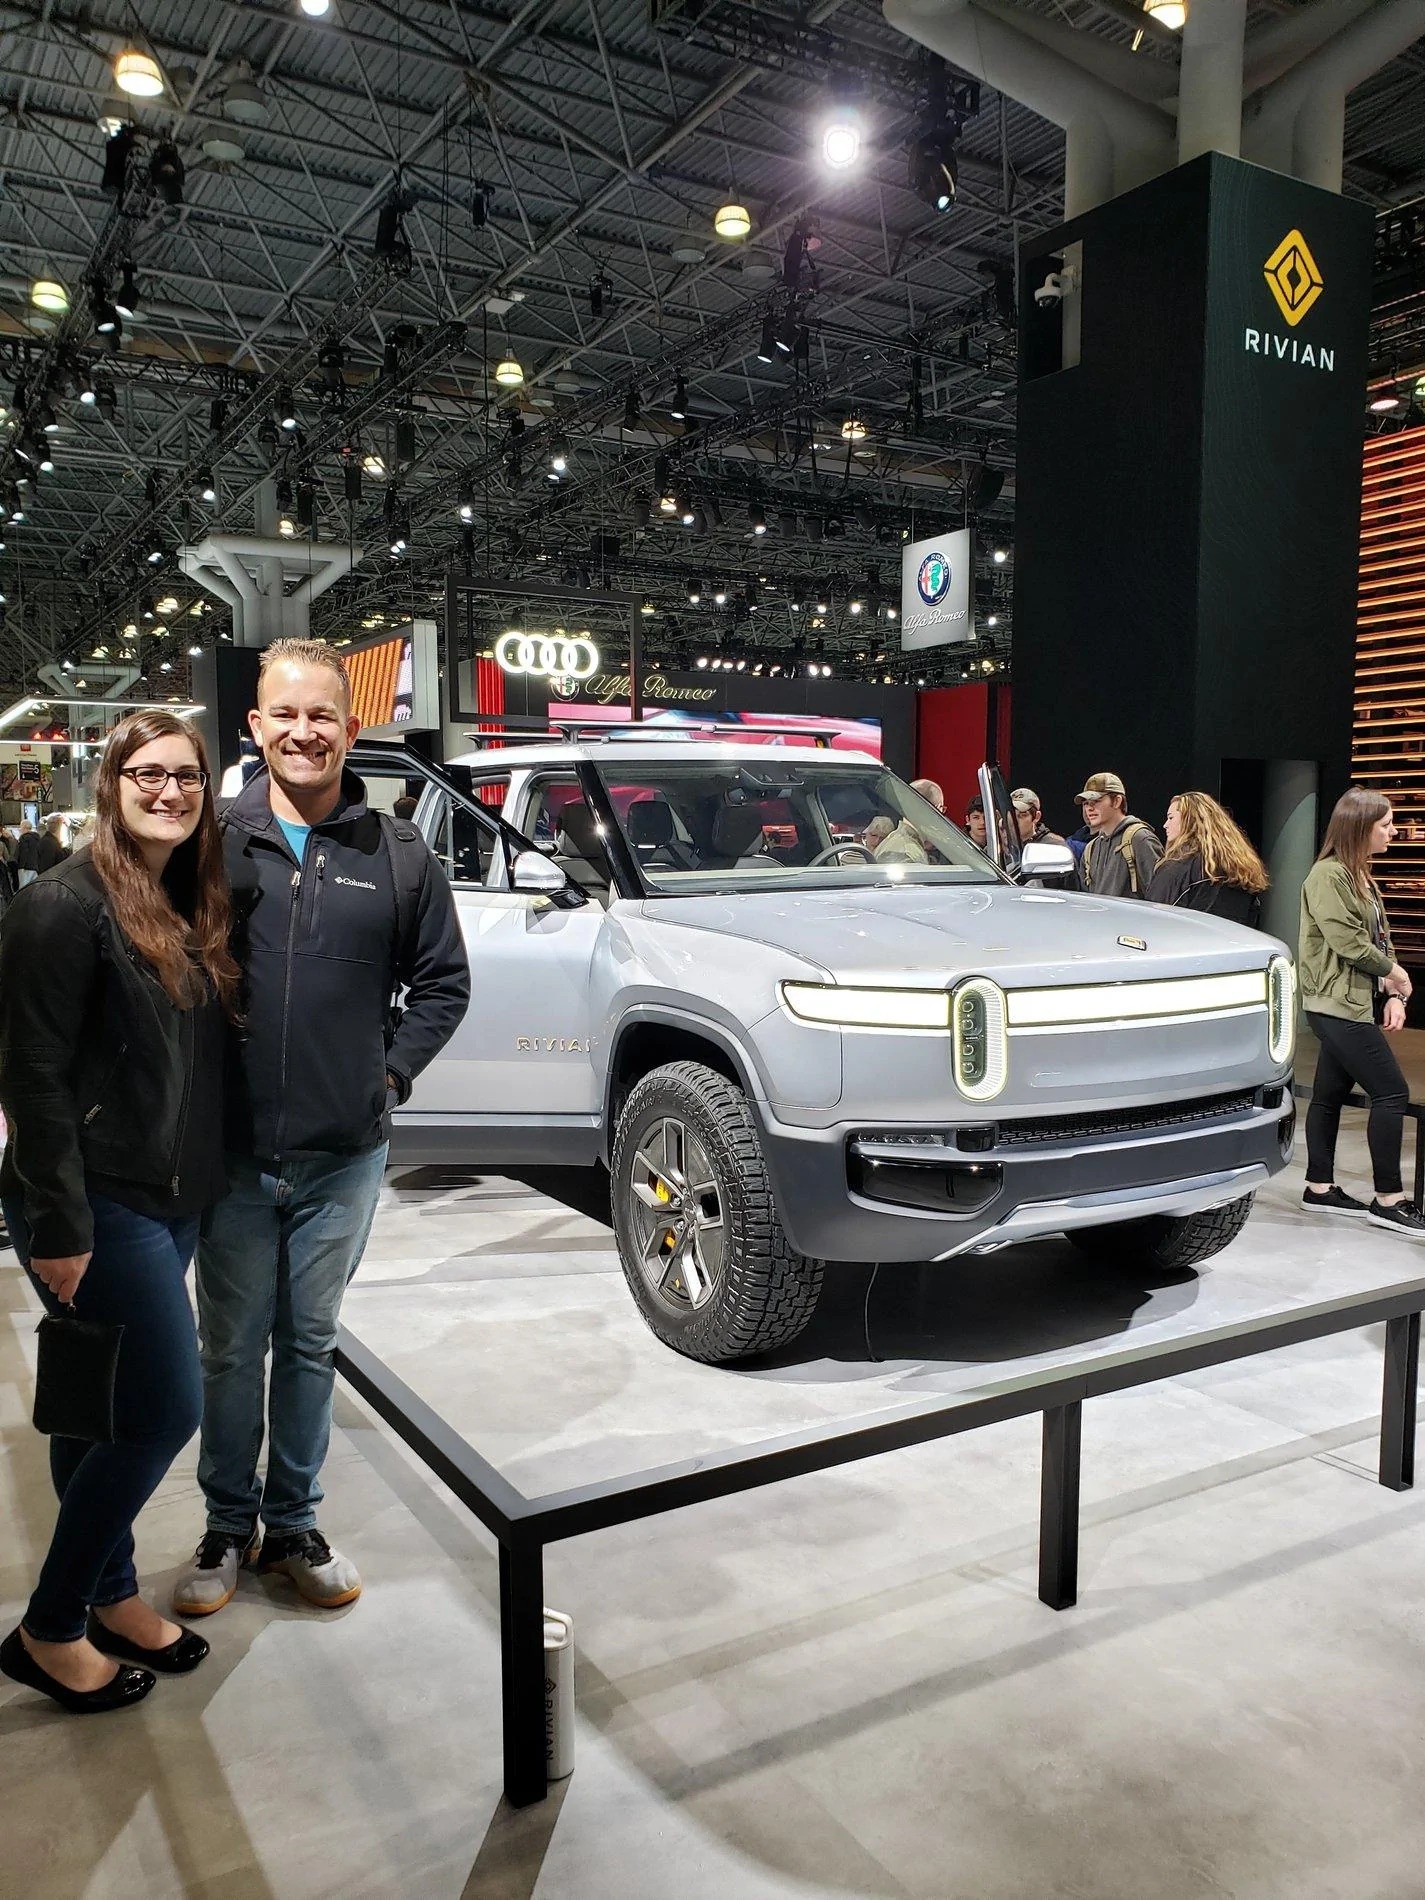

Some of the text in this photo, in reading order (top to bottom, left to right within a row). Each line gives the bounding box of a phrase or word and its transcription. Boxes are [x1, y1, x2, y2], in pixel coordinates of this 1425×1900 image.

[1245, 327, 1335, 372] RIVIAN
[903, 608, 967, 635] Alfa Romeo
[585, 674, 717, 704] Alfa Romeo
[343, 877, 376, 890] Columbia
